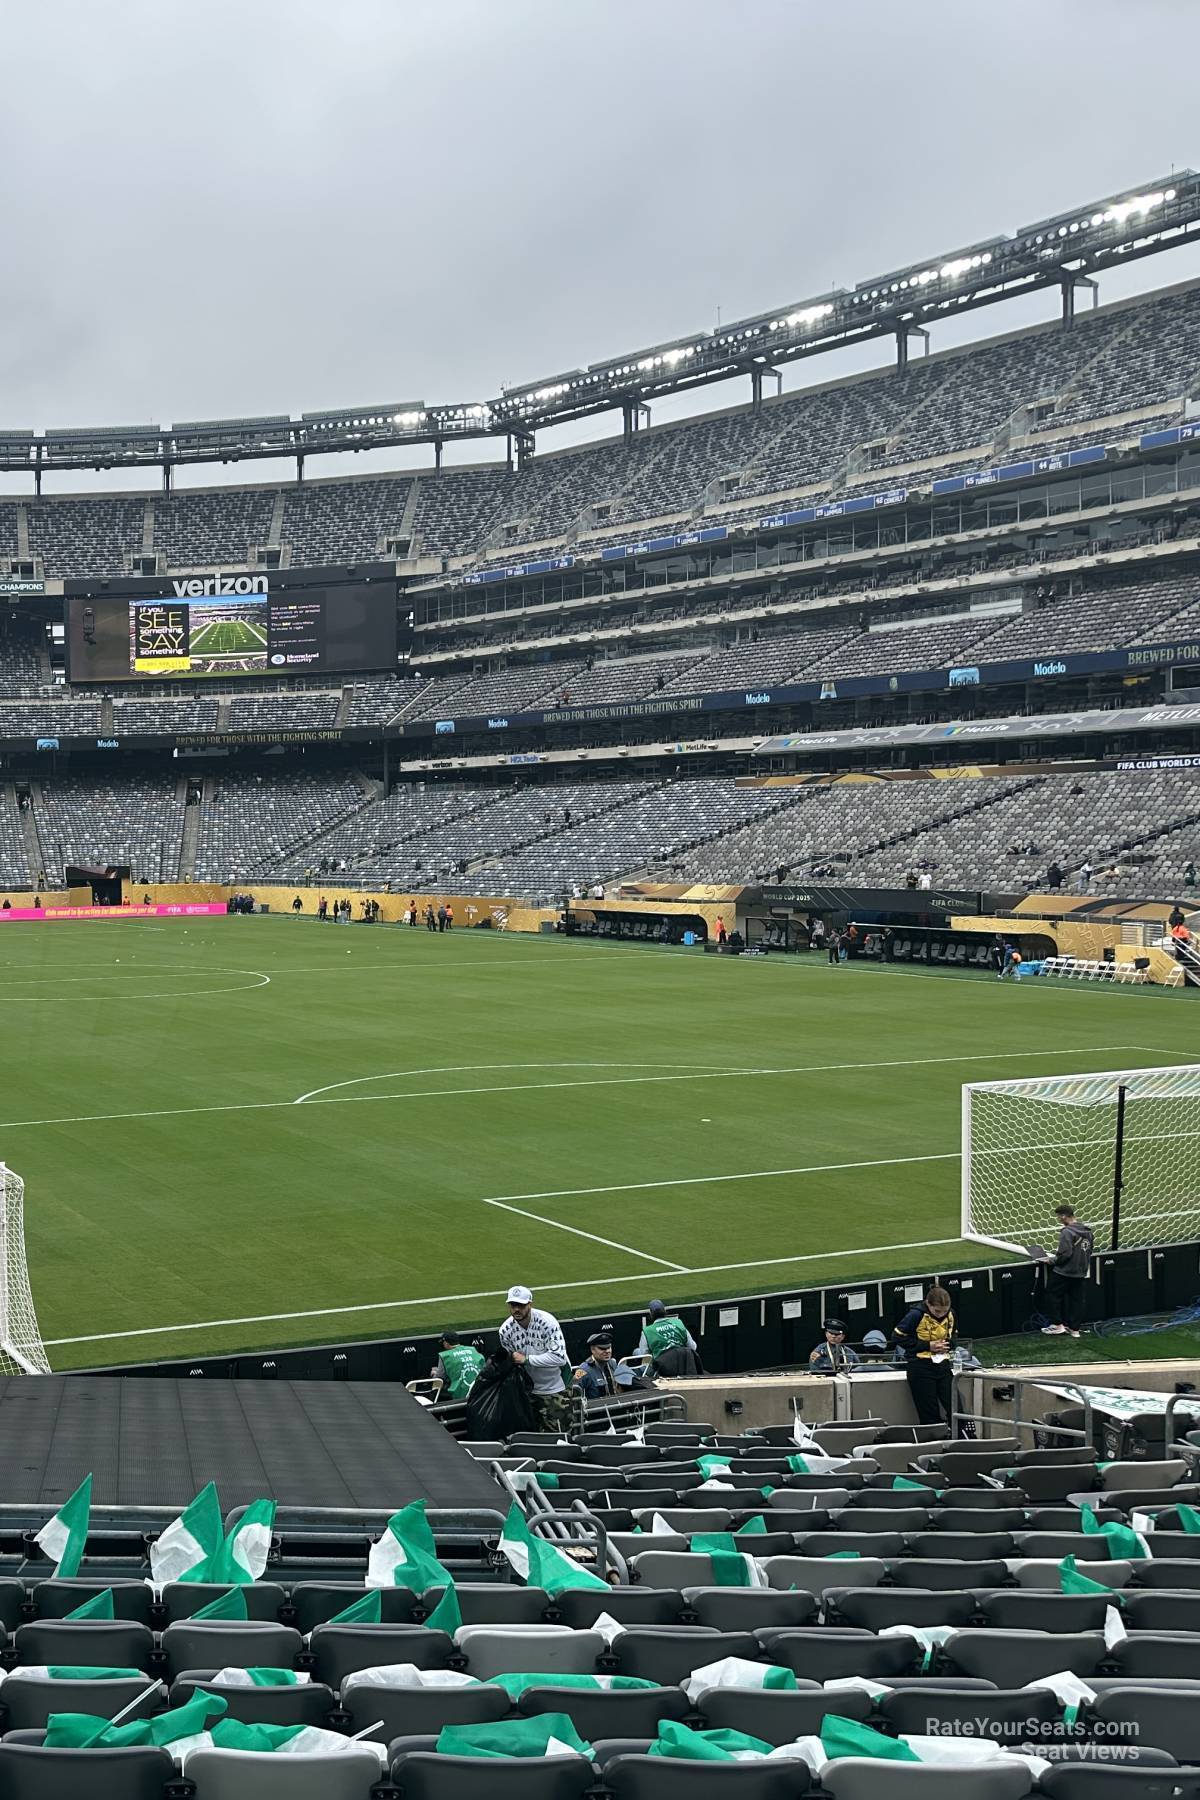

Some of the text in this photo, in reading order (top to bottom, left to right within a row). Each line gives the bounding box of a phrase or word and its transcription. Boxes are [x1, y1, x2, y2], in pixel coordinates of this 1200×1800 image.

[172, 574, 269, 598] verizon
[147, 607, 164, 616] you
[138, 612, 183, 629] SEE
[140, 627, 183, 636] something
[139, 633, 185, 650] SAY
[1128, 645, 1200, 665] BREWED FOR
[1034, 661, 1066, 676] Modelo
[746, 693, 770, 704] Modelo
[543, 699, 703, 722] BREWED FOR THOSE WITH THE FIGHTING SPIRIT
[488, 719, 508, 729] Modelo
[961, 724, 1009, 734] MetLife
[175, 730, 342, 745] BREWED FOR THOSE WITH THE FIGHTING SPIRIT
[800, 736, 838, 745] MetLife
[97, 739, 119, 748] Modelo
[685, 743, 707, 751] MetLife
[1117, 762, 1135, 770] FIFA
[1136, 761, 1158, 769] CLUB
[1159, 759, 1191, 768] WORLD
